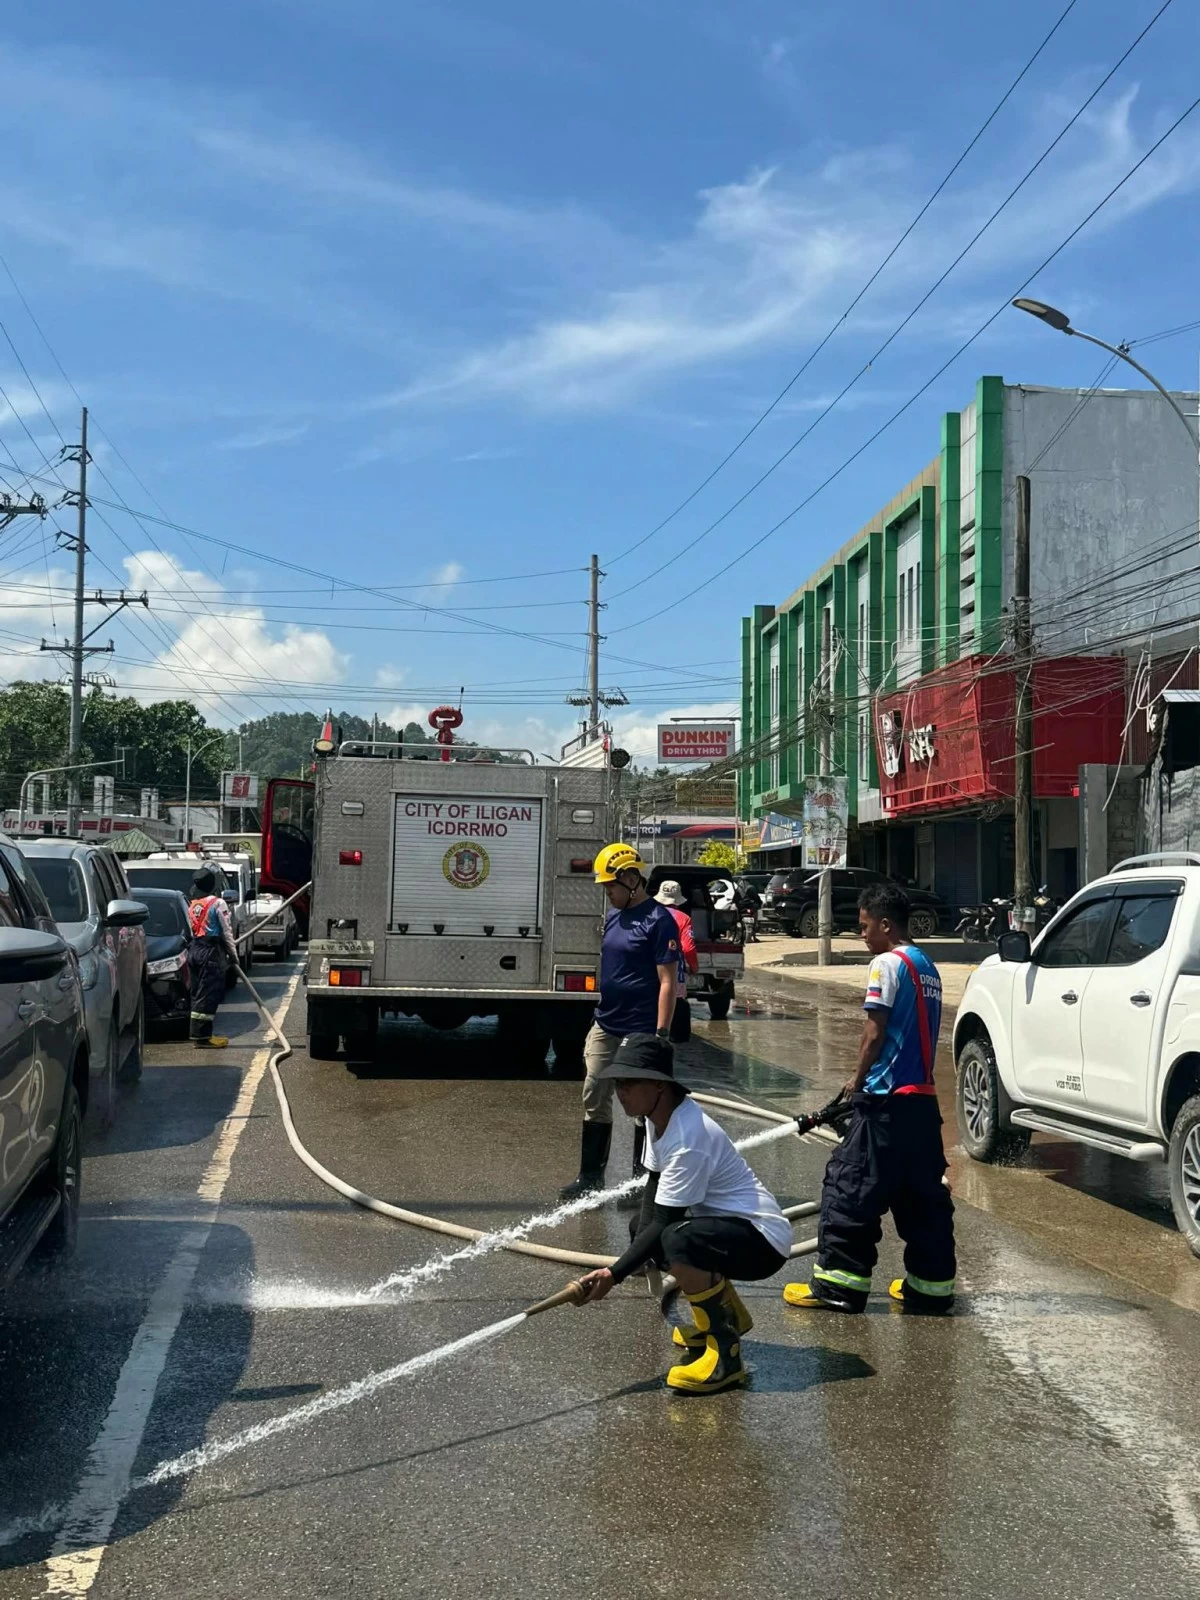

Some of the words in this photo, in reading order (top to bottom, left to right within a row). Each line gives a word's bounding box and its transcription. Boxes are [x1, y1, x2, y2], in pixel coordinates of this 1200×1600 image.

[662, 730, 731, 744] DUNKIN'
[909, 724, 935, 763] KFC
[667, 747, 694, 755] DRIVE
[696, 747, 722, 755] THRU
[404, 802, 443, 818] CITY
[447, 804, 470, 819] OF
[476, 805, 532, 821] ILIGAN
[3, 818, 37, 831] drg
[428, 821, 507, 837] ICDRRMO
